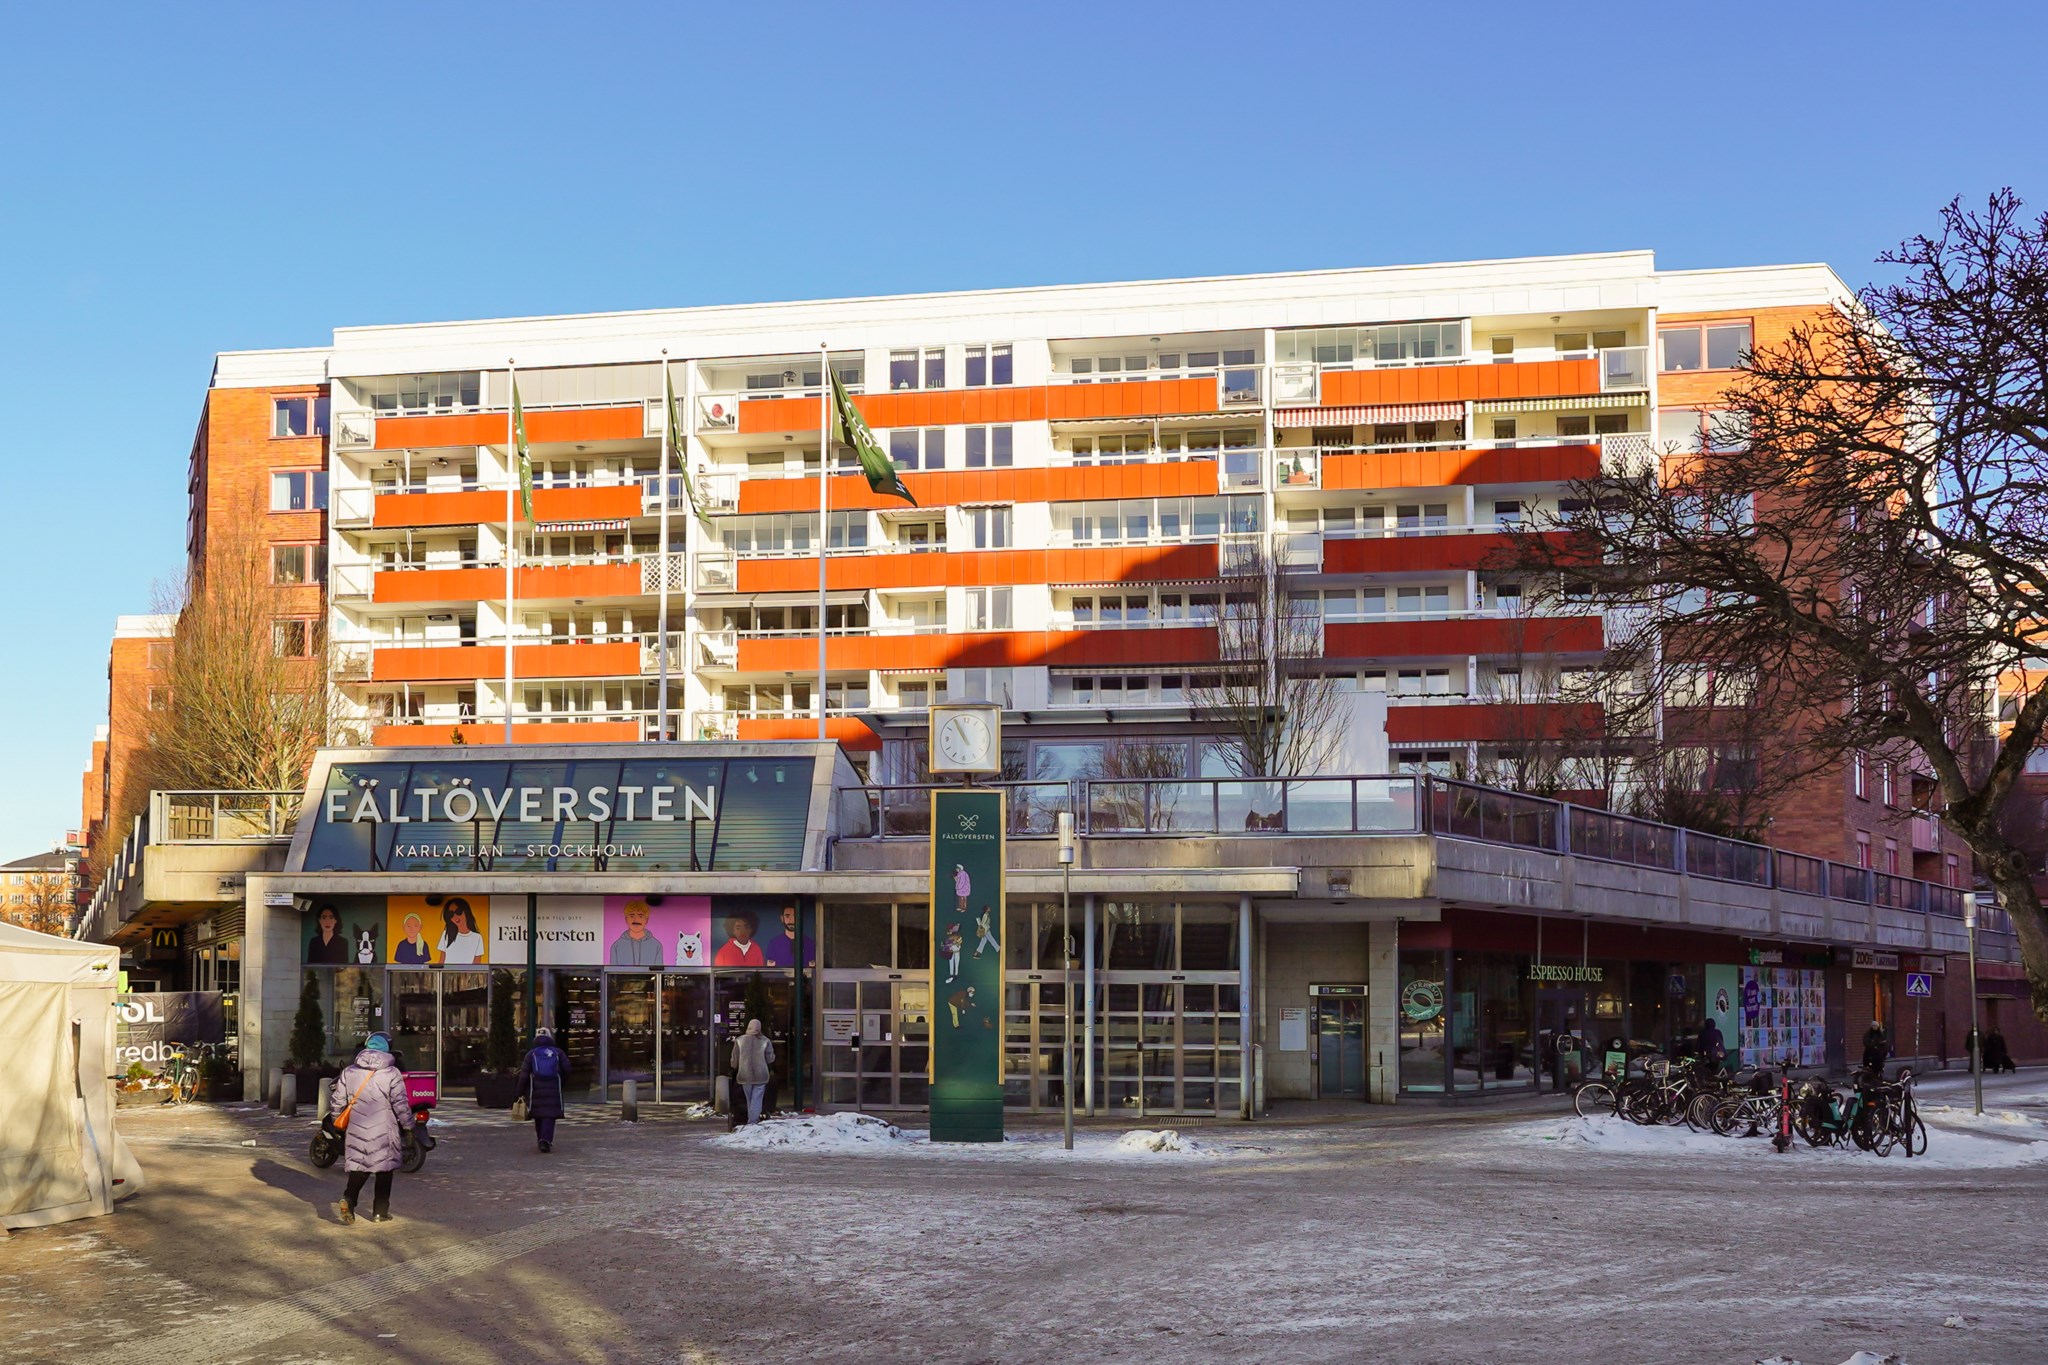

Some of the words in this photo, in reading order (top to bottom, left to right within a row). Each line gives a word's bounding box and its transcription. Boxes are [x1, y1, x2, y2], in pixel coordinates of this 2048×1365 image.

[326, 778, 717, 823] FÄLTÖVERSTEN
[395, 844, 504, 858] KARLAPLAN
[527, 843, 645, 858] STOCKHOLM
[498, 925, 595, 942] Fältversten
[1530, 964, 1574, 981] ESPRESSO
[1574, 966, 1603, 982] HOUSE
[1405, 981, 1440, 997] ESPRESSO
